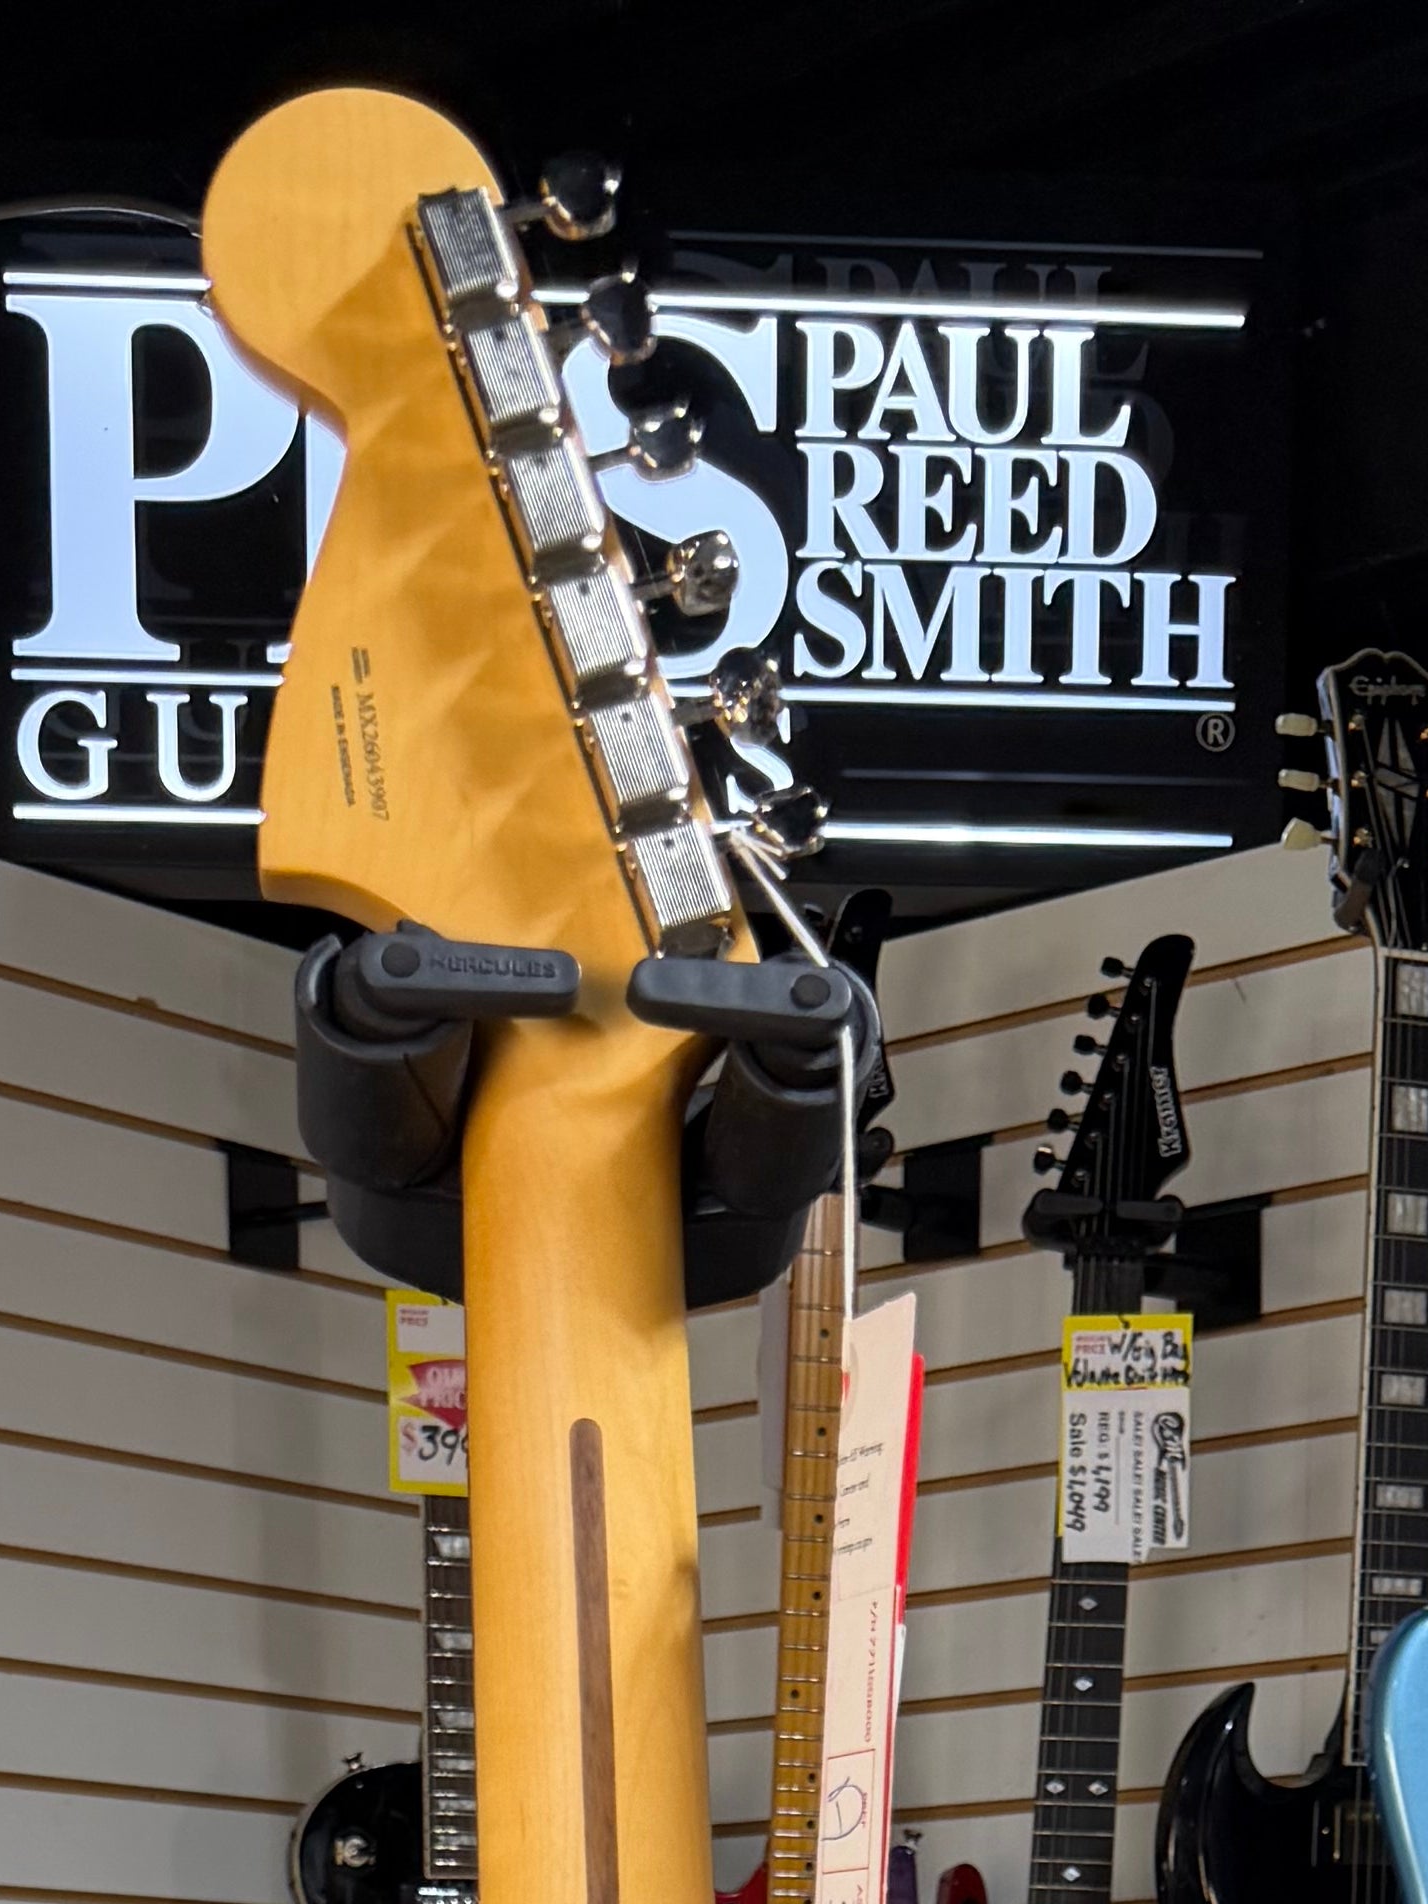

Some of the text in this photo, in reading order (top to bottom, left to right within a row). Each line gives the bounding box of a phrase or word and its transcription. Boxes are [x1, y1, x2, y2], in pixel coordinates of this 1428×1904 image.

[795, 319, 1131, 446] PAUL
[798, 444, 1160, 566] REED
[792, 560, 1237, 690] SMITH
[429, 952, 558, 980] HERCULES
[1068, 1412, 1087, 1459] Sale
